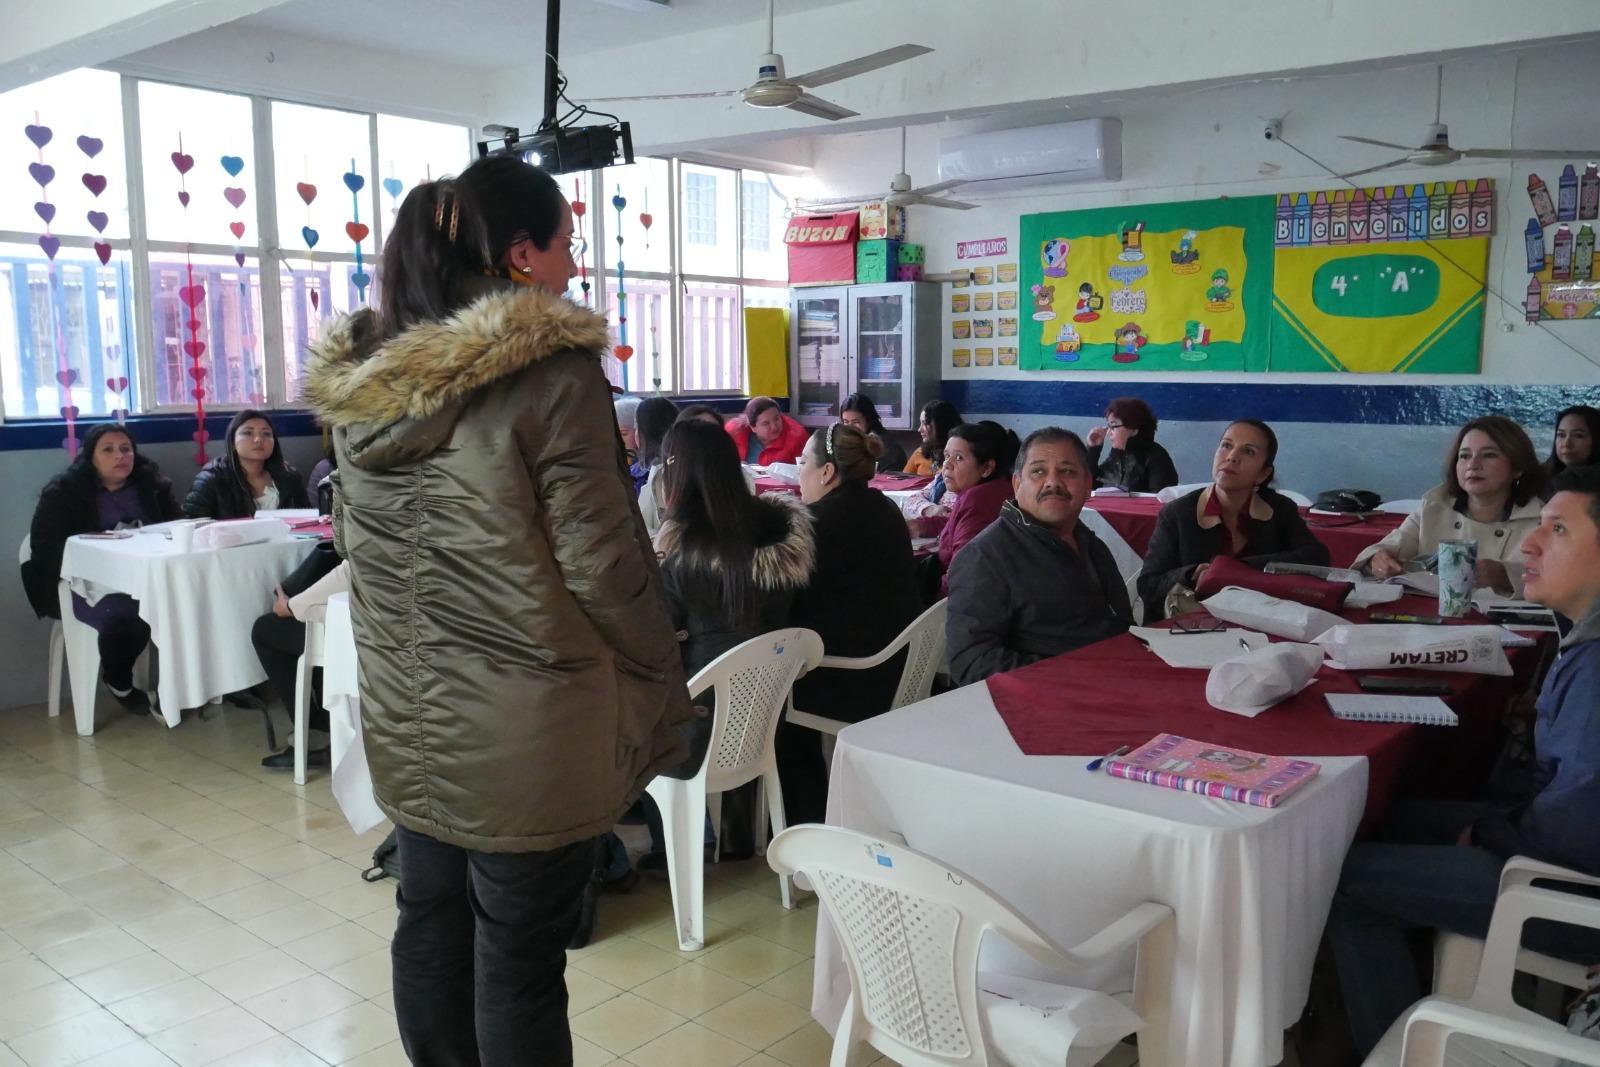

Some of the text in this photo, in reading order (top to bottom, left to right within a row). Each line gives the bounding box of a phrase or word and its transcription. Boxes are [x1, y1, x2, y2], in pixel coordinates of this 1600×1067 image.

[1276, 207, 1489, 240] Bienvenidos
[785, 225, 849, 242] BUZON
[1111, 296, 1145, 306] Febrero
[1389, 649, 1469, 664] CRETAM
